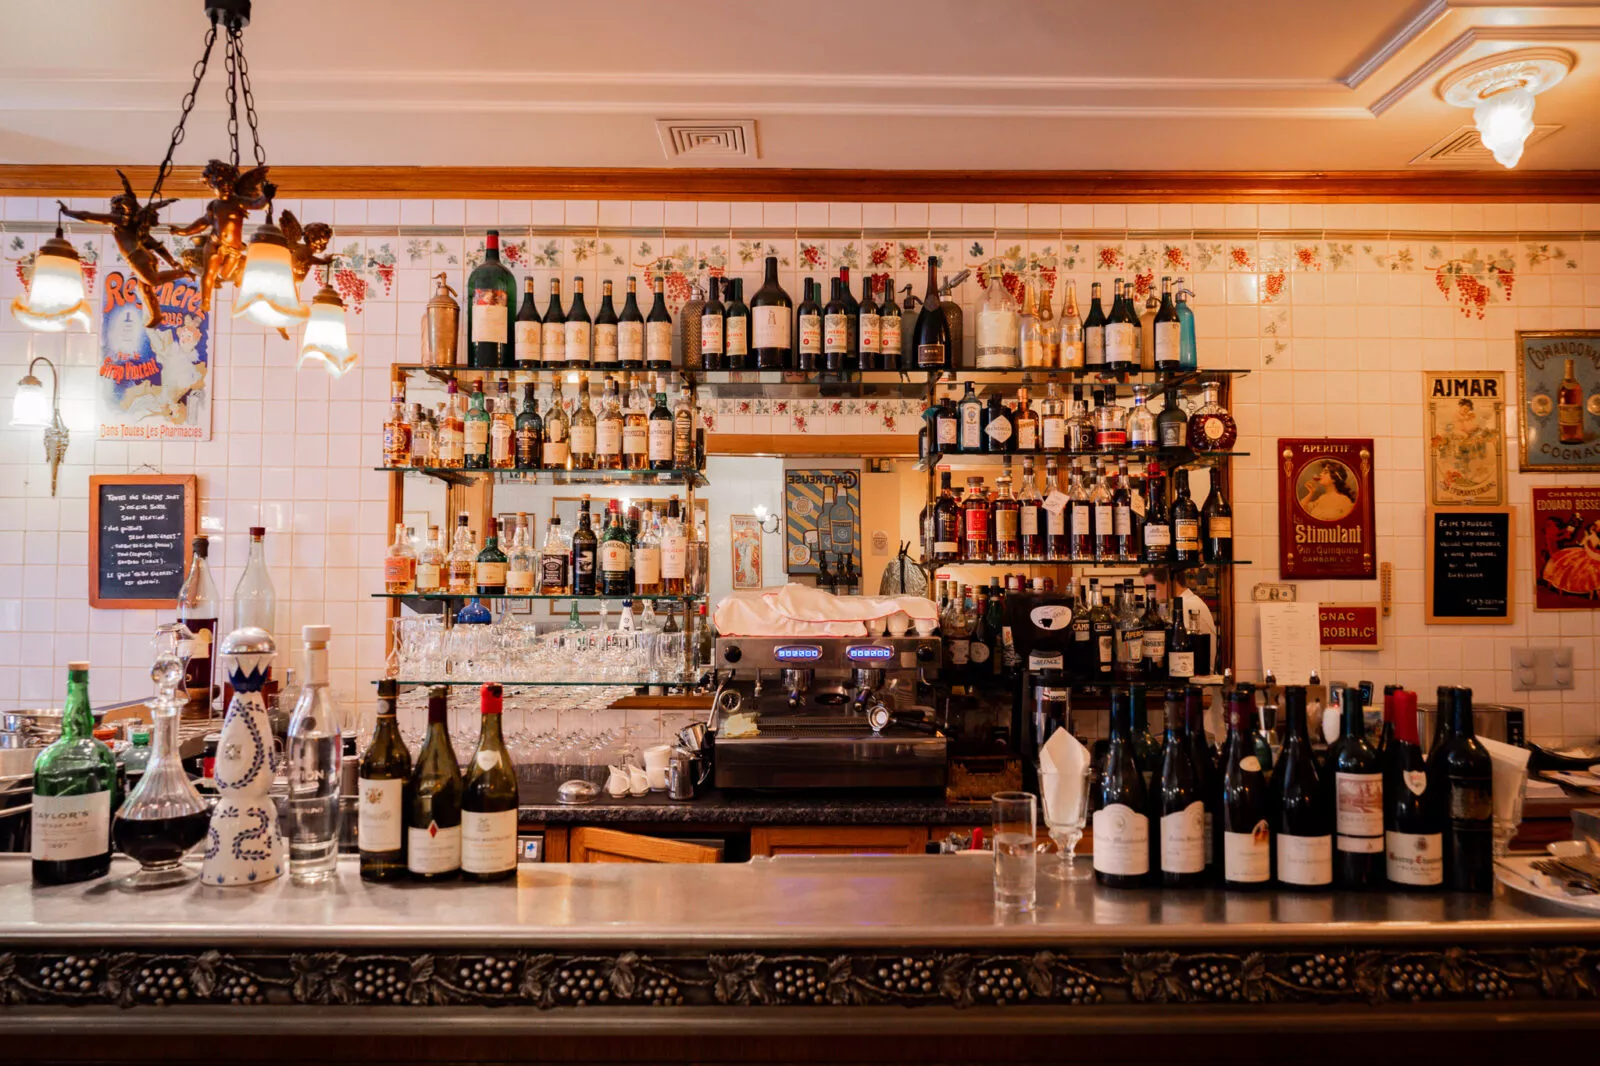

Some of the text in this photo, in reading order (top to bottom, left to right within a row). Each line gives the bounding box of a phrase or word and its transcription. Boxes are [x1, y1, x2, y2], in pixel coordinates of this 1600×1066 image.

[160, 311, 183, 327] ous
[1432, 379, 1498, 397] AJMAR
[1295, 524, 1362, 543] Stimulant
